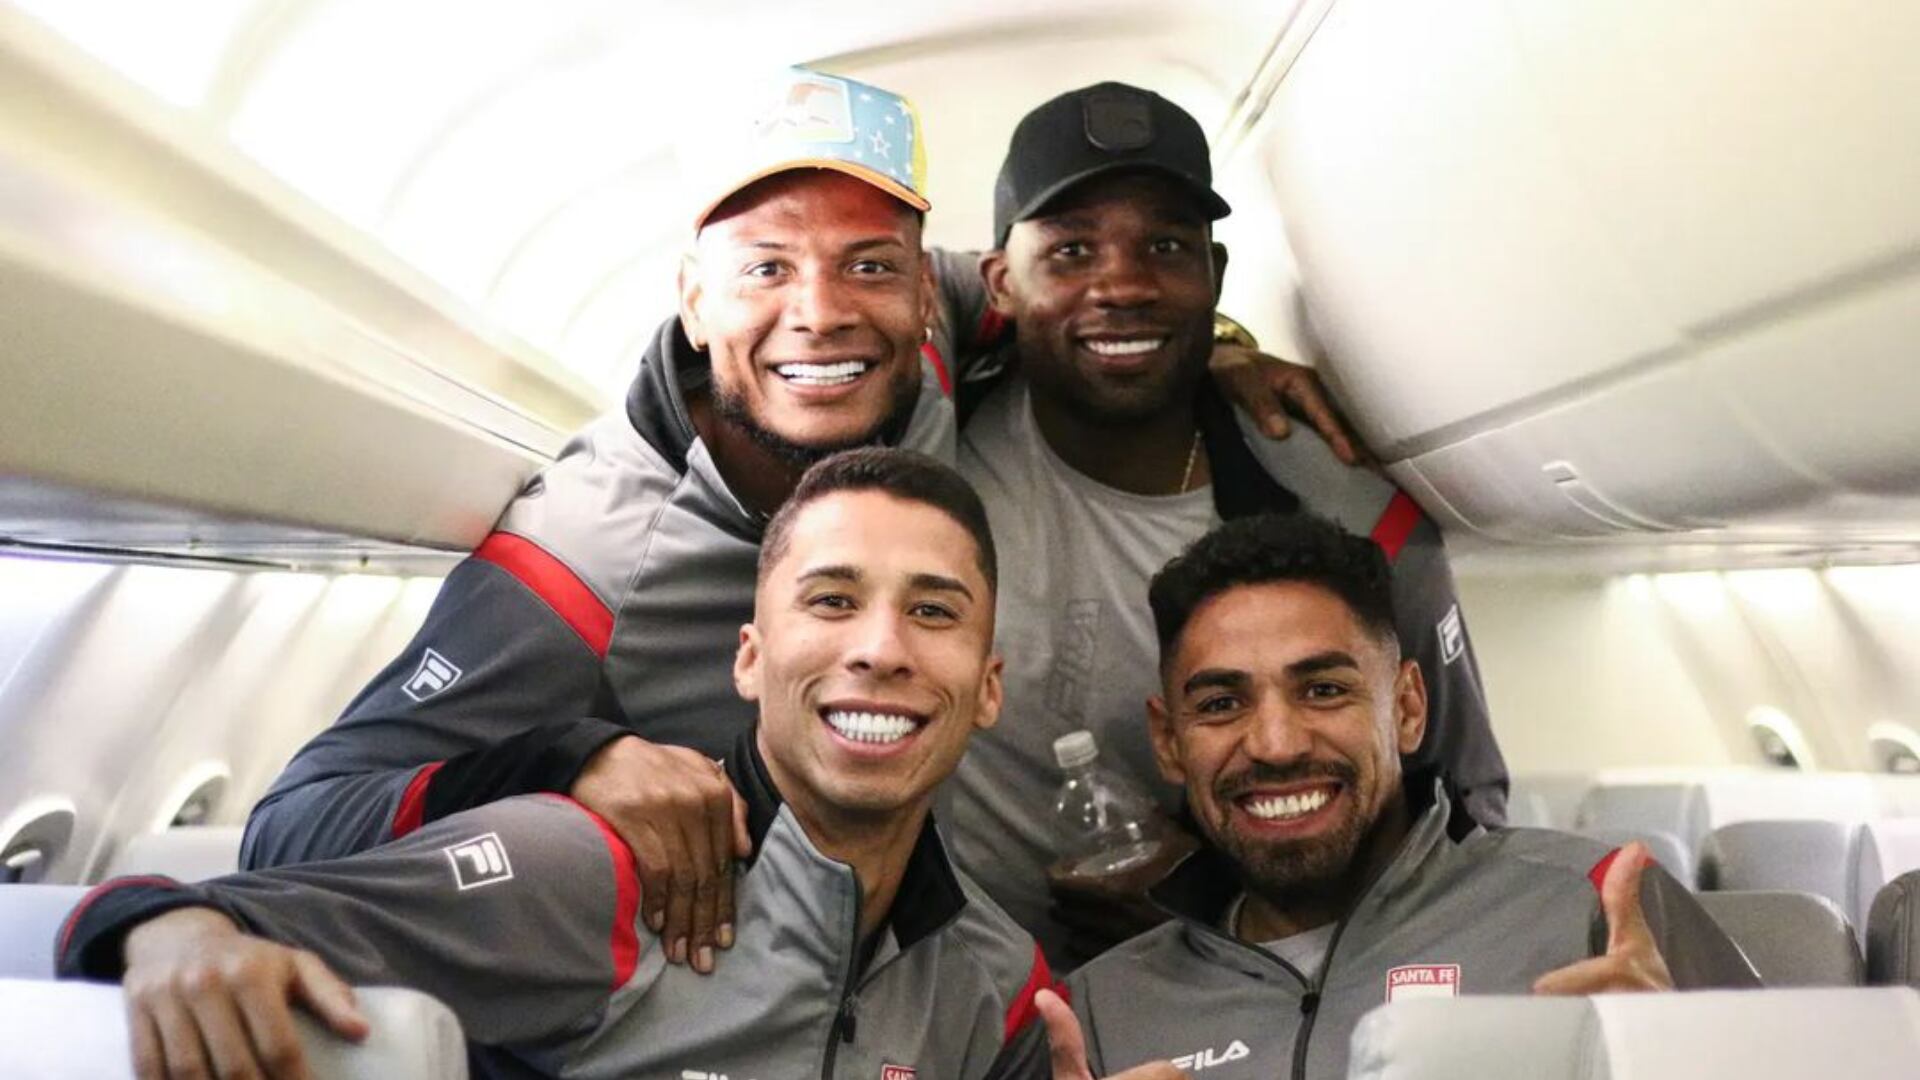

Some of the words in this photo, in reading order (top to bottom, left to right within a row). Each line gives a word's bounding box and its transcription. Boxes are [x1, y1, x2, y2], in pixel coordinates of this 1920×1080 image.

[1391, 970, 1435, 985] SANTA
[1438, 968, 1455, 983] FE
[1171, 1040, 1250, 1071] FILA
